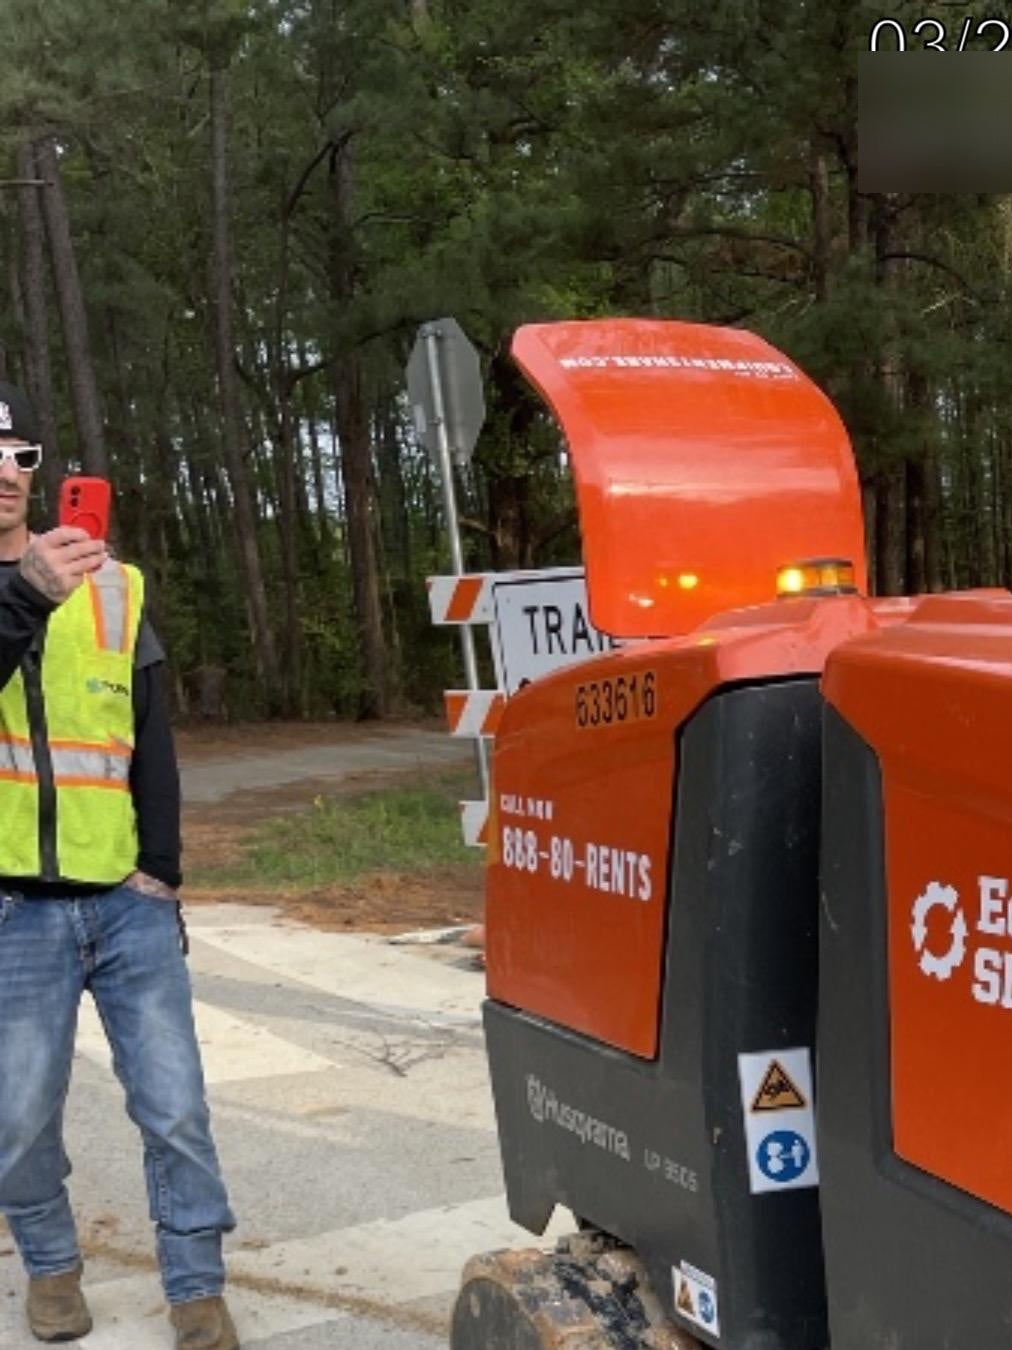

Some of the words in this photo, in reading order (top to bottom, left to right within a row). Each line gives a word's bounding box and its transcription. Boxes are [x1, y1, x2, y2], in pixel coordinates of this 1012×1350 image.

[522, 602, 626, 655] TRA
[576, 671, 656, 728] 633616
[502, 824, 652, 901] 888-80-RENTS
